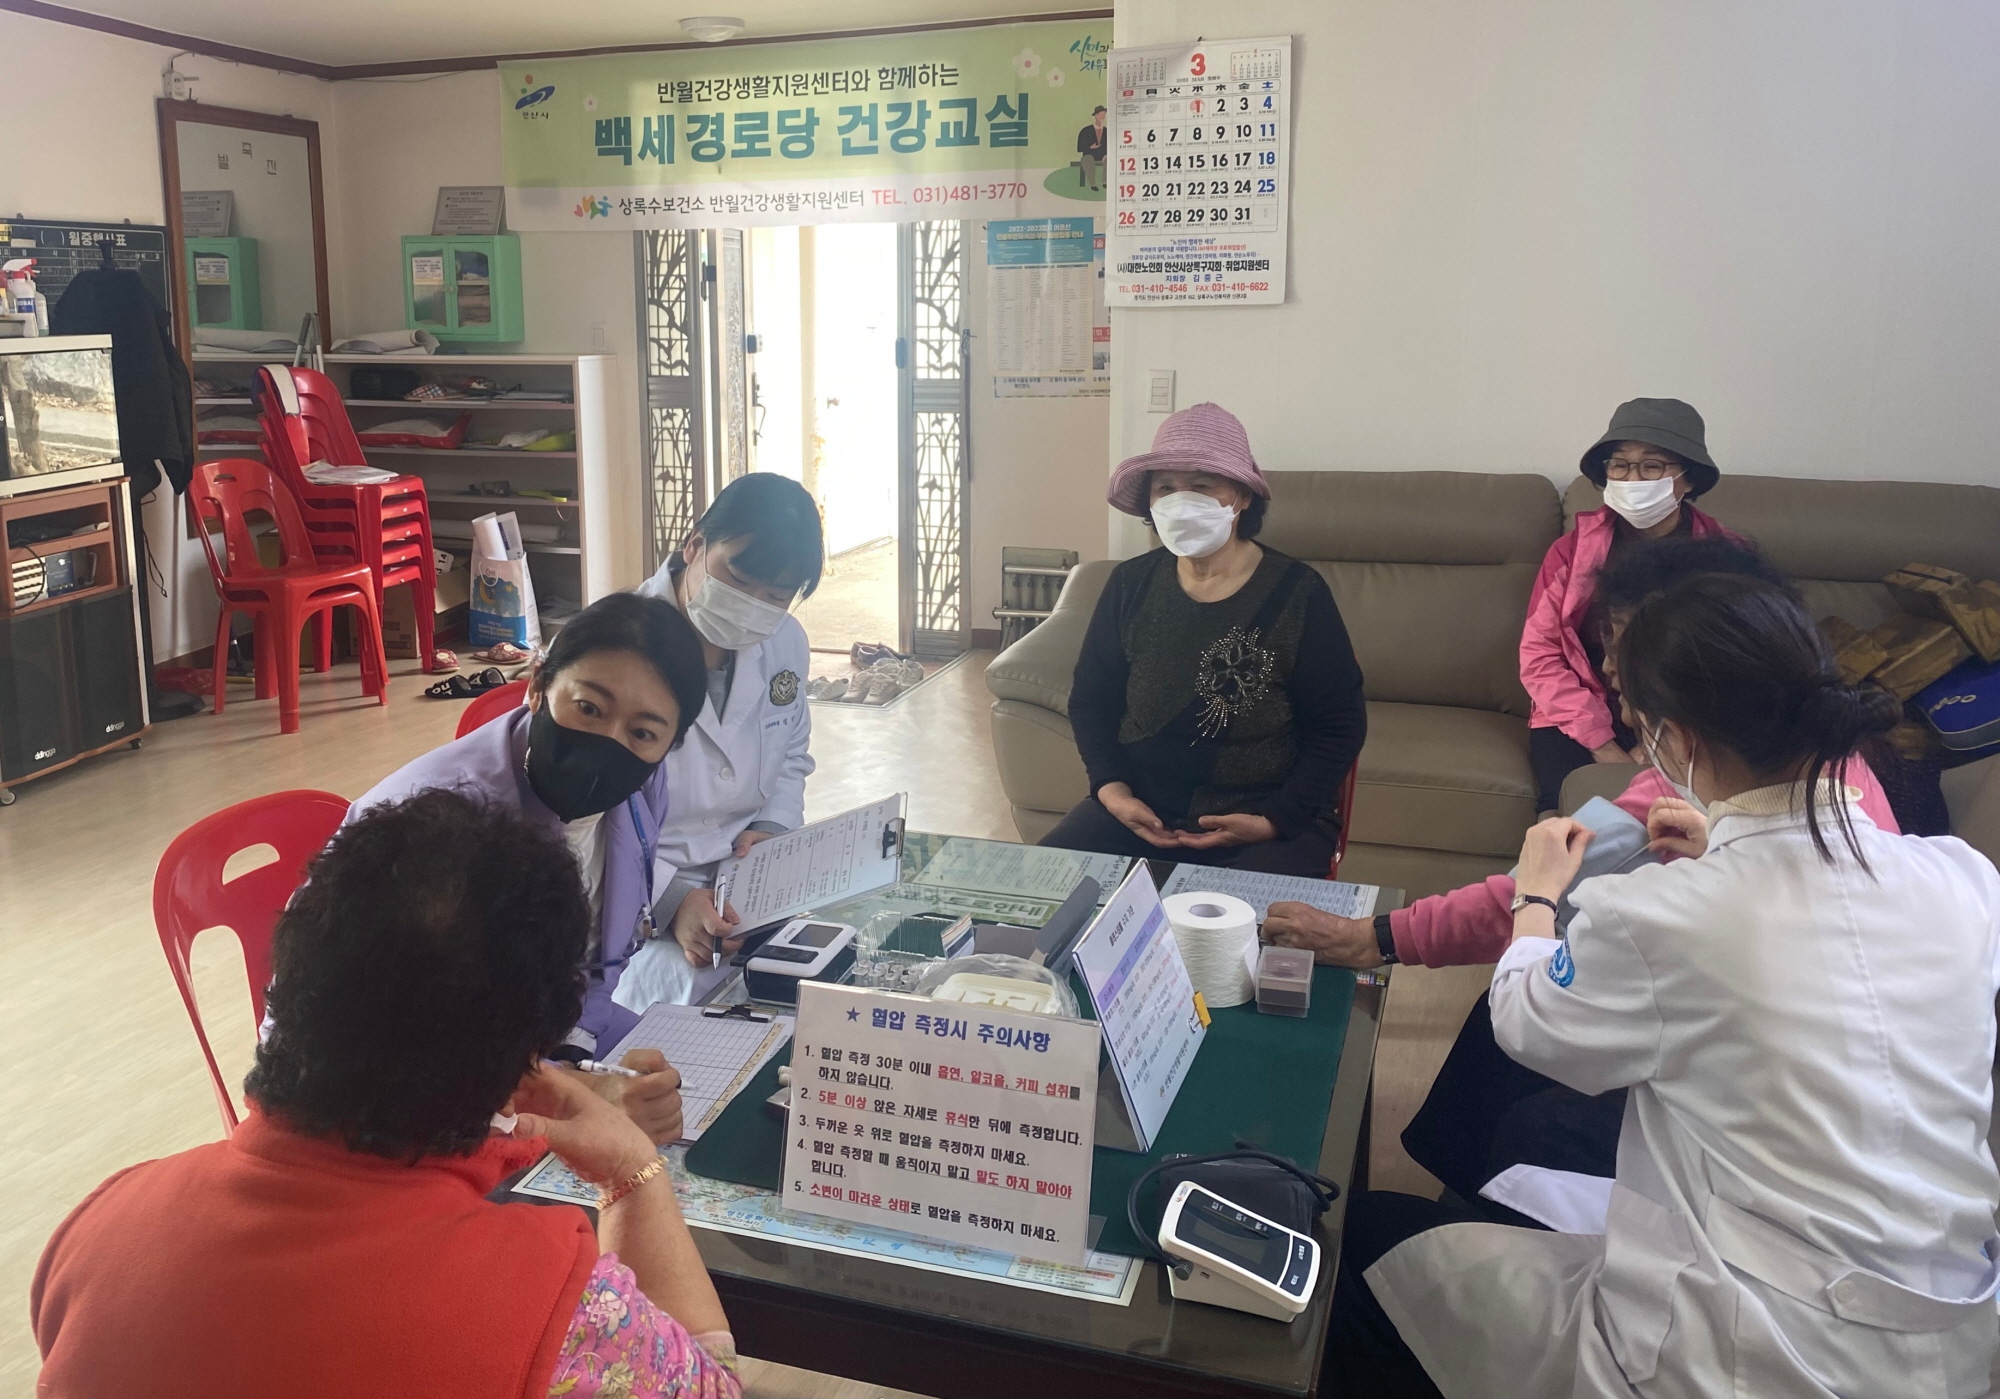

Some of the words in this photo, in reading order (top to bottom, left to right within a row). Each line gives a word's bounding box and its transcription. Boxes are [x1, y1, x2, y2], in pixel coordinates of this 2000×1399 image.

[1191, 53, 1206, 75] 3
[658, 73, 869, 104] 반월건강생활지원센터와
[878, 62, 959, 92] 함께하는
[1169, 87, 1180, 95] 火
[1194, 99, 1201, 112] 1
[1217, 98, 1225, 112] 2
[1240, 97, 1249, 110] 3
[1263, 95, 1272, 109] 4
[595, 114, 675, 165] 백세
[686, 108, 820, 163] 경로당
[836, 92, 1030, 154] 건강교실
[1123, 131, 1132, 144] 5
[1147, 129, 1156, 142] 6
[1170, 129, 1179, 141] 7
[1193, 128, 1202, 140] 8
[1216, 126, 1225, 139] 9
[1236, 125, 1252, 138] 10
[1260, 124, 1275, 136] 11
[1120, 158, 1135, 171] 12
[1143, 157, 1159, 170] 13
[1165, 156, 1182, 169] 14
[1188, 155, 1205, 168] 15
[1212, 154, 1228, 166] 16
[1235, 153, 1251, 165] 17
[1259, 152, 1275, 165] 18
[618, 194, 705, 216] 상록수보건소
[710, 188, 864, 214] 반월건강생활지원센터
[872, 188, 908, 206] TEL.
[913, 182, 1027, 206] 031)481-3770
[1119, 185, 1135, 198] 19
[1142, 184, 1159, 197] 20
[1166, 183, 1182, 196] 21
[1188, 182, 1205, 195] 22
[1211, 181, 1229, 194] 23
[1234, 180, 1251, 193] 24
[1258, 179, 1275, 192] 25
[1119, 212, 1135, 224] 26
[1141, 211, 1159, 224] 27
[1164, 210, 1182, 223] 28
[1187, 209, 1205, 222] 29
[1210, 208, 1228, 221] 30
[1235, 207, 1251, 220] 31
[1117, 262, 1162, 273] (사)대한노인회
[872, 1007, 906, 1030] 혈압
[915, 1014, 968, 1040] 측정시
[977, 1023, 1051, 1052] 주의사항
[804, 1045, 814, 1058] 1.
[821, 1047, 842, 1062] 혈압
[848, 1051, 870, 1066] 측정
[876, 1055, 903, 1071] 30분
[909, 1060, 931, 1076] 이내
[937, 1065, 963, 1081] 흡연,
[970, 1070, 1008, 1088] 알코올,
[1015, 1077, 1038, 1093] 커피
[818, 1068, 841, 1083] 하지
[846, 1072, 893, 1090] 않습니다.
[801, 1088, 811, 1100] 2.
[818, 1090, 837, 1105] 5분
[845, 1094, 867, 1109] 이상
[874, 1099, 896, 1114] 앉은
[904, 1103, 938, 1121] 자세로
[945, 1111, 980, 1129] 휴식한
[988, 1118, 1011, 1134] 뒤에
[1019, 1123, 1082, 1145] 측정합니다.
[799, 1115, 809, 1128] 3.
[815, 1117, 848, 1134] 두꺼운
[853, 1123, 864, 1137] 옷
[871, 1126, 892, 1141] 위로
[899, 1131, 932, 1148] 혈압을
[939, 1139, 985, 1158] 측정하지
[991, 1148, 1029, 1166] 마세요.
[797, 1139, 807, 1150] 4.
[813, 1140, 835, 1156] 혈압
[840, 1145, 873, 1162] 측정할
[879, 1152, 889, 1166] 때
[896, 1155, 941, 1175] 움직이지
[948, 1164, 970, 1180] 말고
[976, 1170, 999, 1186] 말도
[1006, 1175, 1029, 1191] 하지
[1036, 1180, 1072, 1199] 말아야
[811, 1160, 846, 1178] 합니다.
[794, 1181, 804, 1193] 5.
[810, 1184, 843, 1201] 소변이
[849, 1190, 881, 1207] 마려운
[888, 1198, 921, 1215] 상태로
[928, 1205, 961, 1223] 혈압을
[968, 1213, 1014, 1234] 측정하지
[1020, 1223, 1059, 1242] 마세요.
